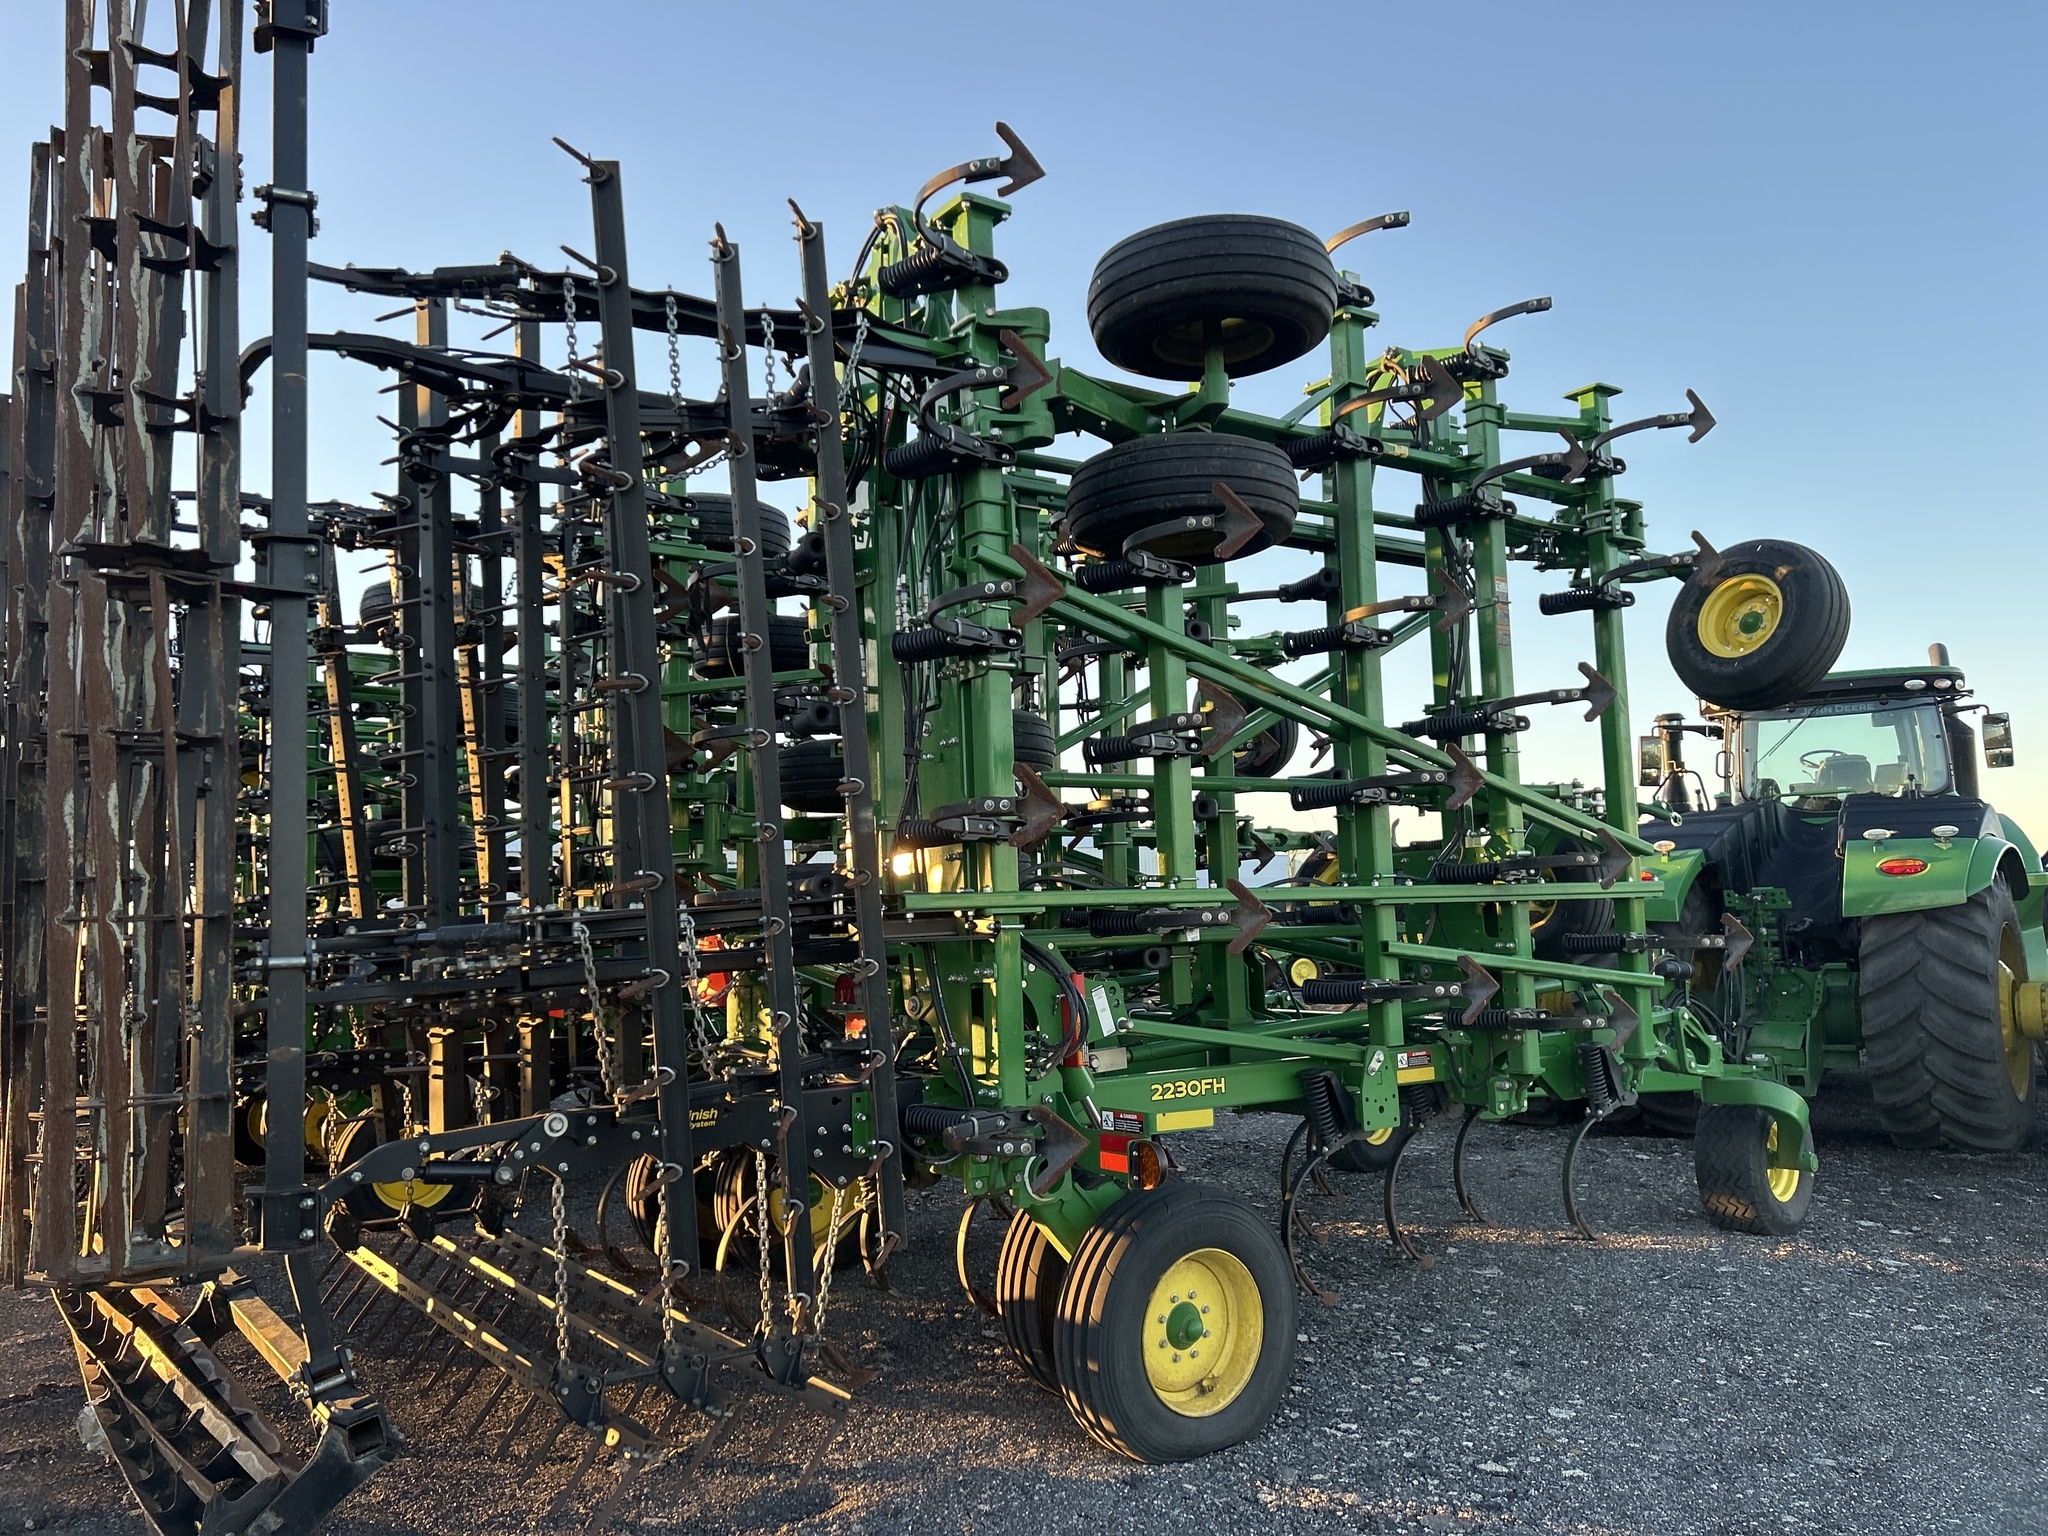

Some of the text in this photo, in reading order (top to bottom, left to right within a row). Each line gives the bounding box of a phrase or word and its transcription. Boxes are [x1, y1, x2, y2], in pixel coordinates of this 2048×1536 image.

[1834, 703, 1875, 713] DEERE
[1150, 1077, 1226, 1101] 2230FH
[689, 1107, 718, 1121] inish
[689, 1120, 716, 1130] ystem
